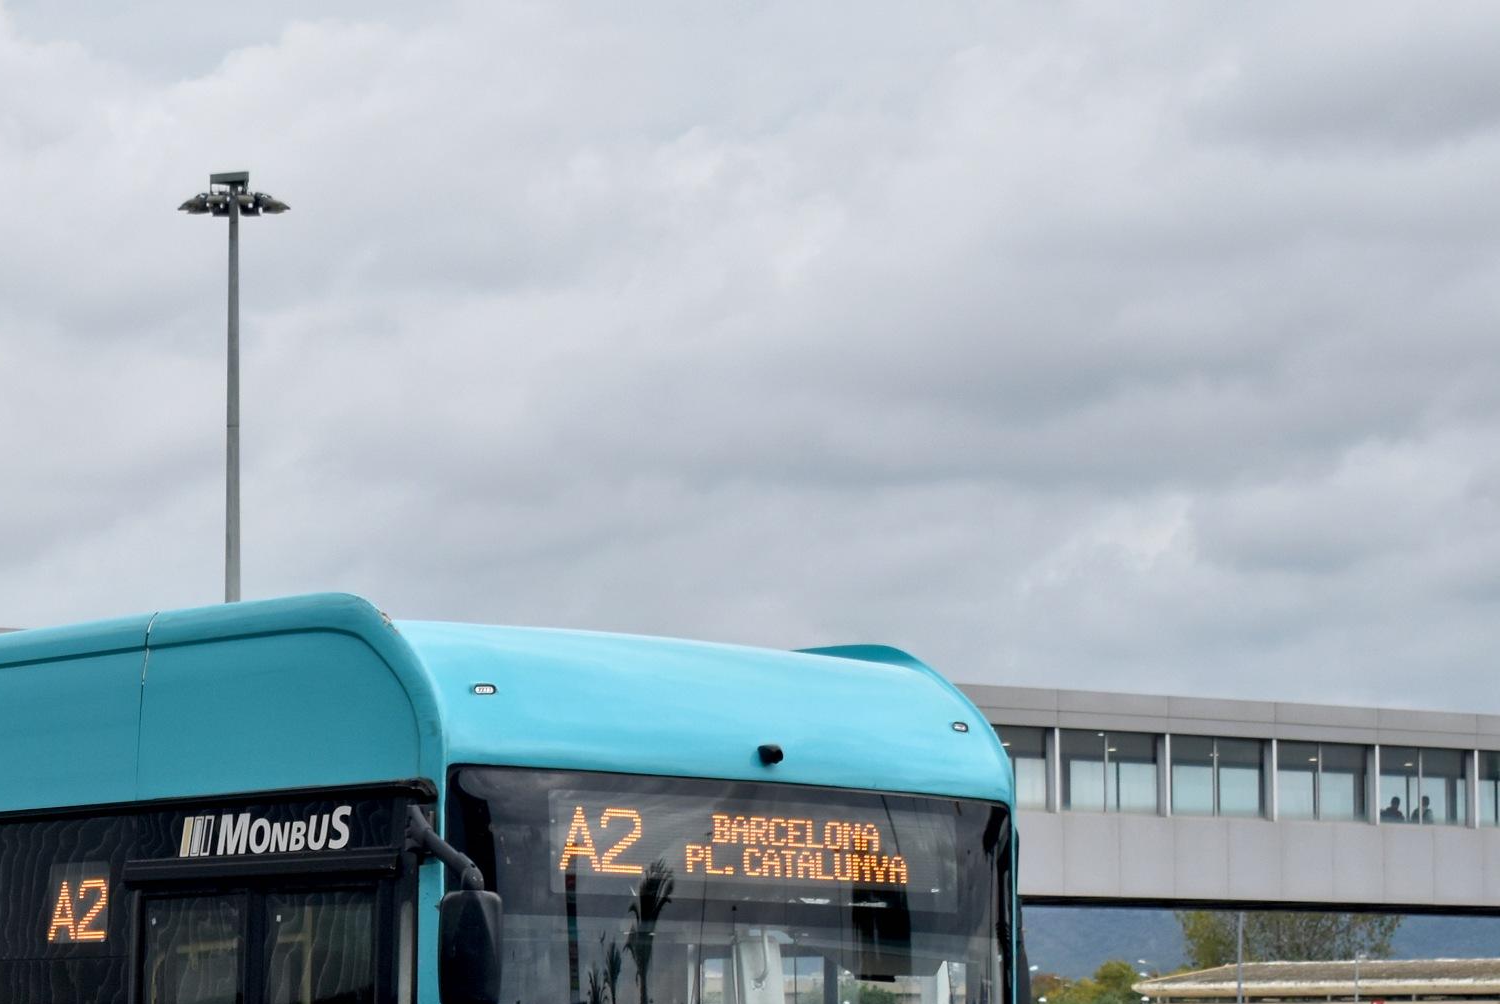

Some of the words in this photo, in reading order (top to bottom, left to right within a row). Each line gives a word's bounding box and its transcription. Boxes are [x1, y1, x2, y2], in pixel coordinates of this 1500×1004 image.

[559, 806, 643, 874] A2
[712, 814, 880, 852] BARCELONA
[685, 844, 735, 876] PL.
[743, 848, 908, 885] CATALUNYA
[47, 879, 107, 941] A2
